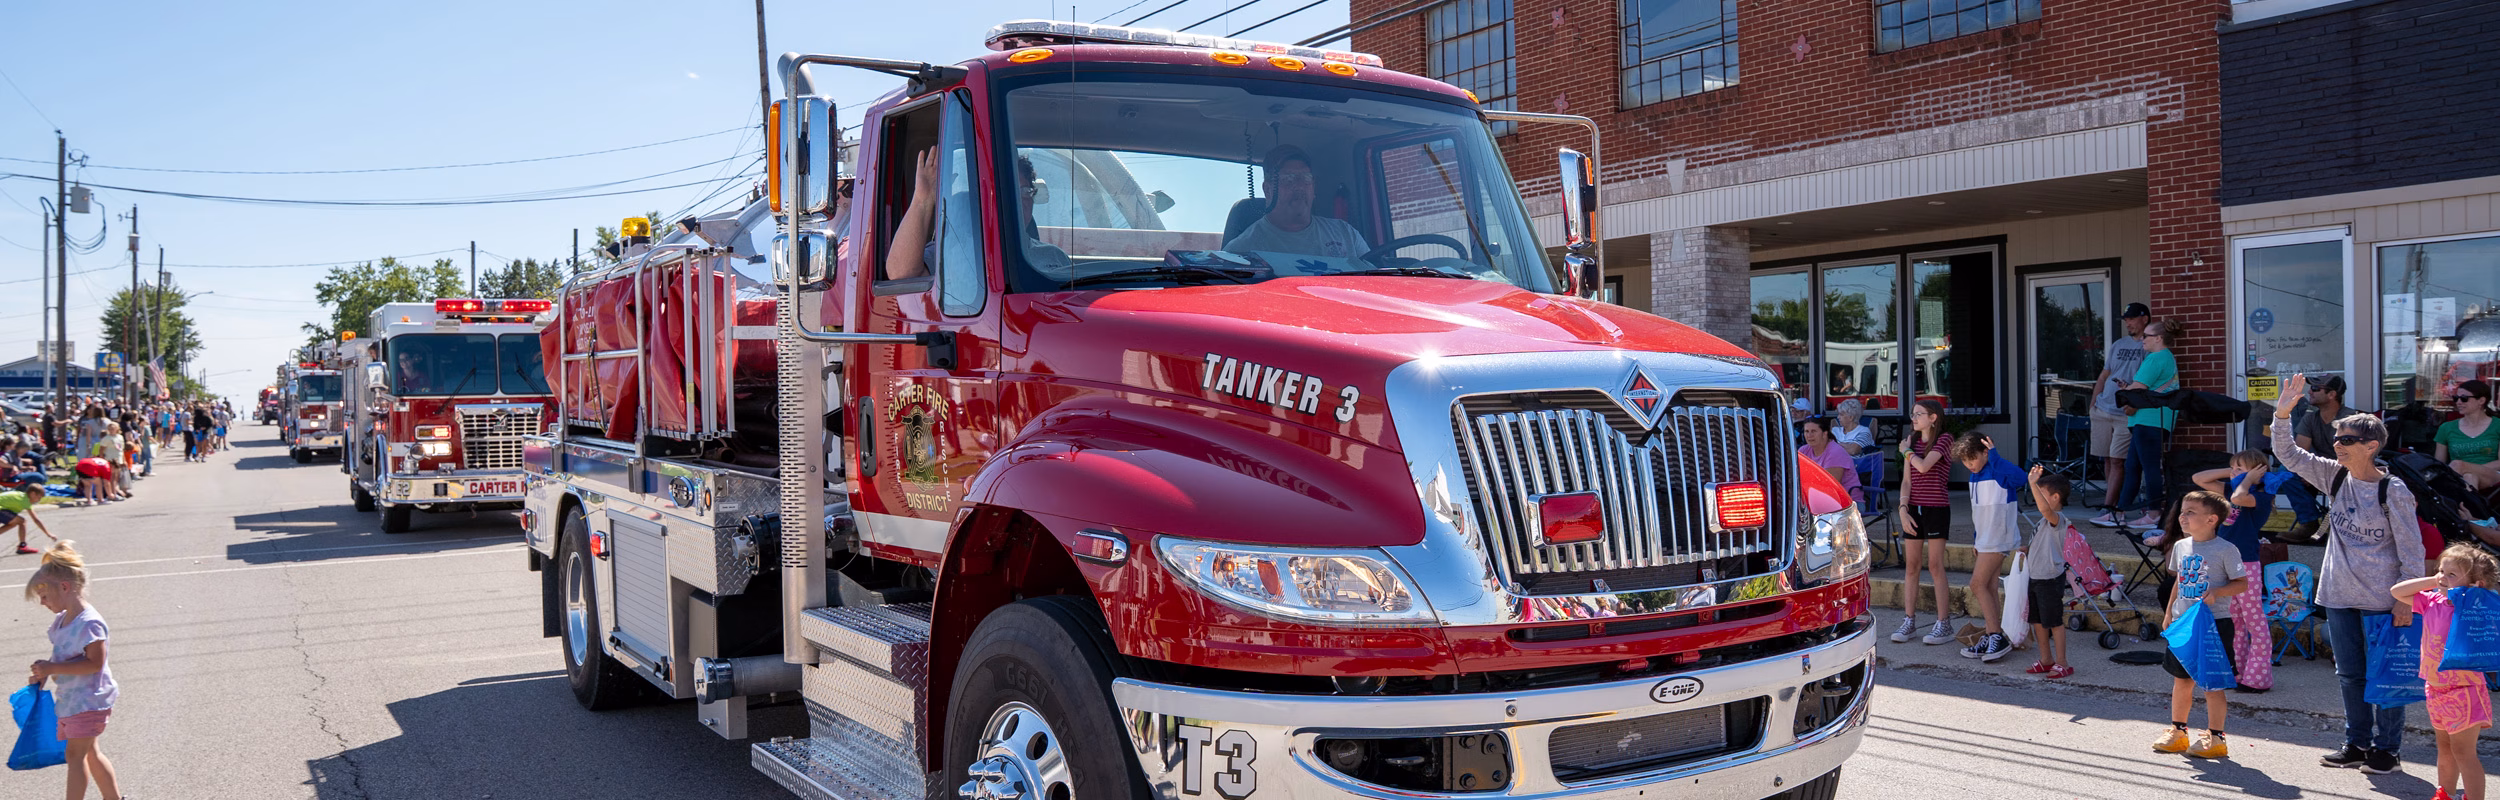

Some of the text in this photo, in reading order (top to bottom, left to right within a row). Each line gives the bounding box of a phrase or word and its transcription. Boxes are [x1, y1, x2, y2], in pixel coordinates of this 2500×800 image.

[887, 384, 949, 422] CARTER FIRE
[1202, 352, 1360, 424] TANKER 3
[940, 421, 951, 502] RESCUE
[470, 480, 517, 494] CARTER
[906, 492, 948, 512] DISTRICT
[2330, 510, 2385, 542] tlinburg
[1006, 661, 1048, 702] G661
[1659, 683, 1696, 698] E-ONE
[1175, 723, 1257, 800] T3
